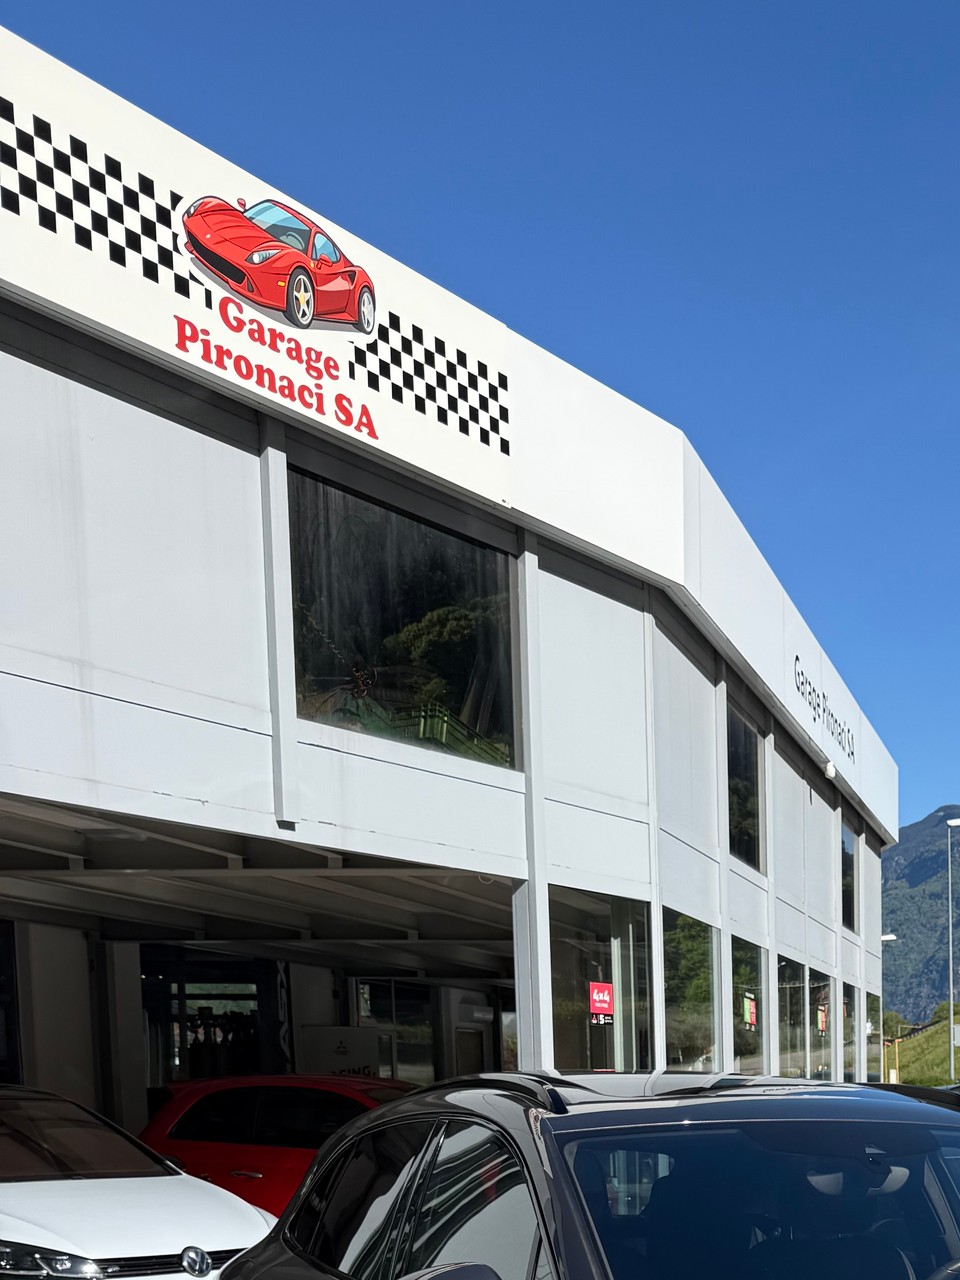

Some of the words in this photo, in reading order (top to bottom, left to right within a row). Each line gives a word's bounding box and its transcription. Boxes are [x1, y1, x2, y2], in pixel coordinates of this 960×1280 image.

[173, 314, 326, 416] Pironaci
[333, 392, 380, 441] SA
[218, 296, 340, 381] Garage
[794, 654, 821, 723] Garage
[822, 691, 846, 754] Pironaci
